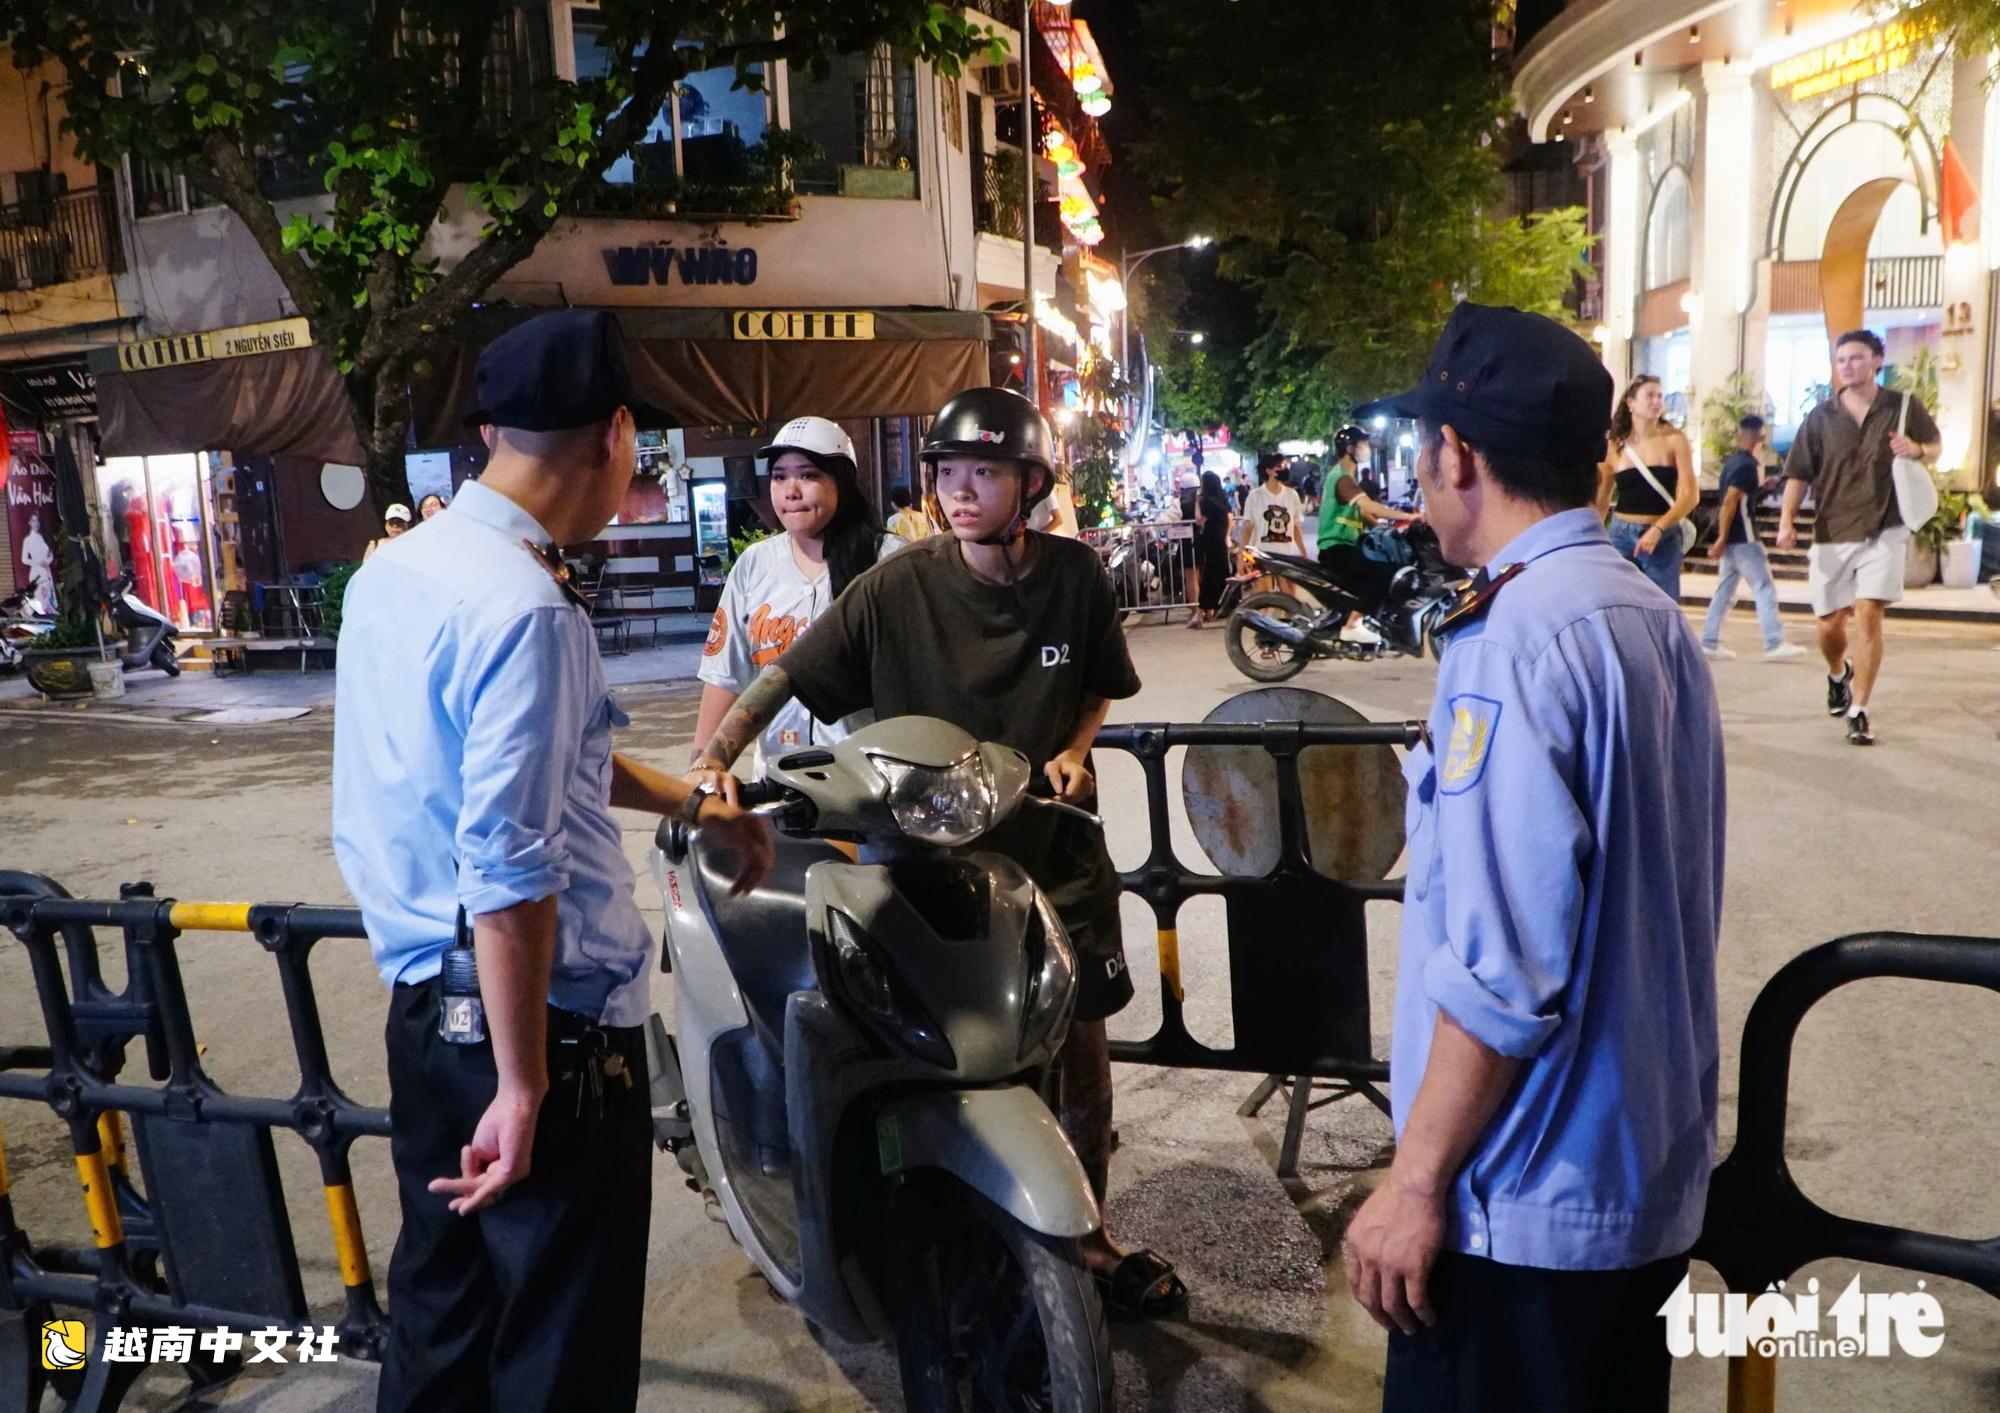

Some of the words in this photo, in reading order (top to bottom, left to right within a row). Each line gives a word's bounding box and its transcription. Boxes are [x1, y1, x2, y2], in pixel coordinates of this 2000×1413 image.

[737, 313, 865, 339] COFFEE
[124, 334, 208, 370] COFFEE
[225, 340, 233, 355] 2
[1041, 643, 1071, 668] D2
[451, 1010, 469, 1027] 02
